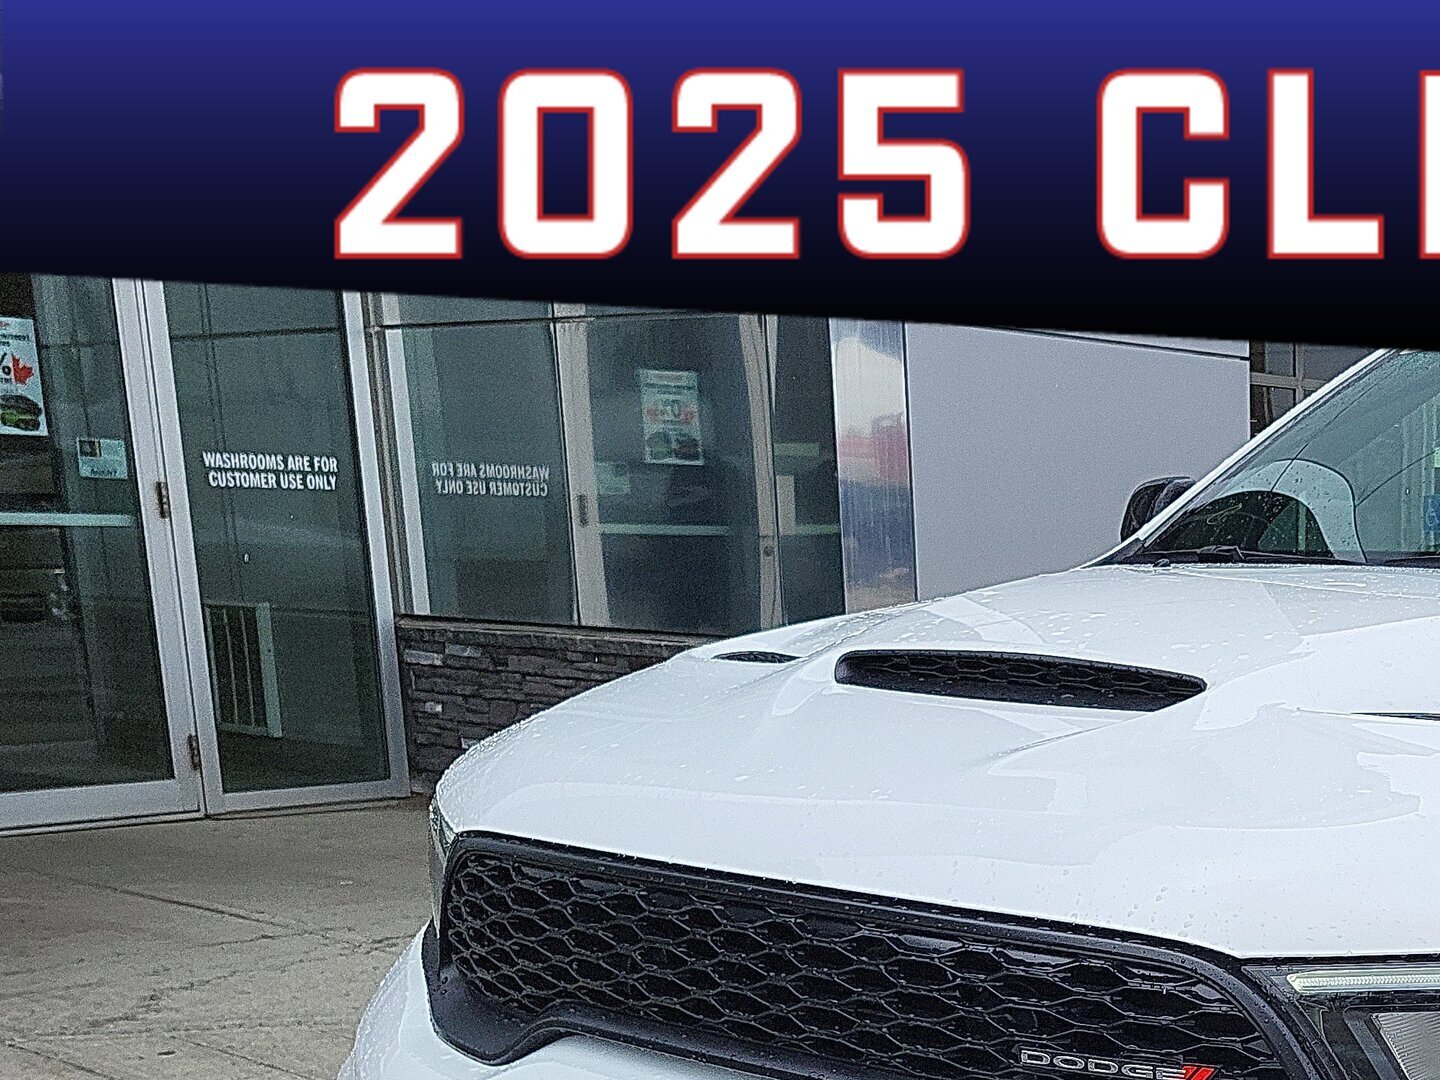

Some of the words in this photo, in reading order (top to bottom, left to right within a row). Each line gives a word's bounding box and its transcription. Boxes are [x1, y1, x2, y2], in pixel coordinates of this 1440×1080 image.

[202, 451, 285, 471] WASHROOMS
[287, 454, 312, 472] ARE
[313, 456, 339, 473] FOR
[208, 469, 278, 489] CUSTOMER
[279, 472, 305, 490] USE
[306, 473, 337, 490] ONLY
